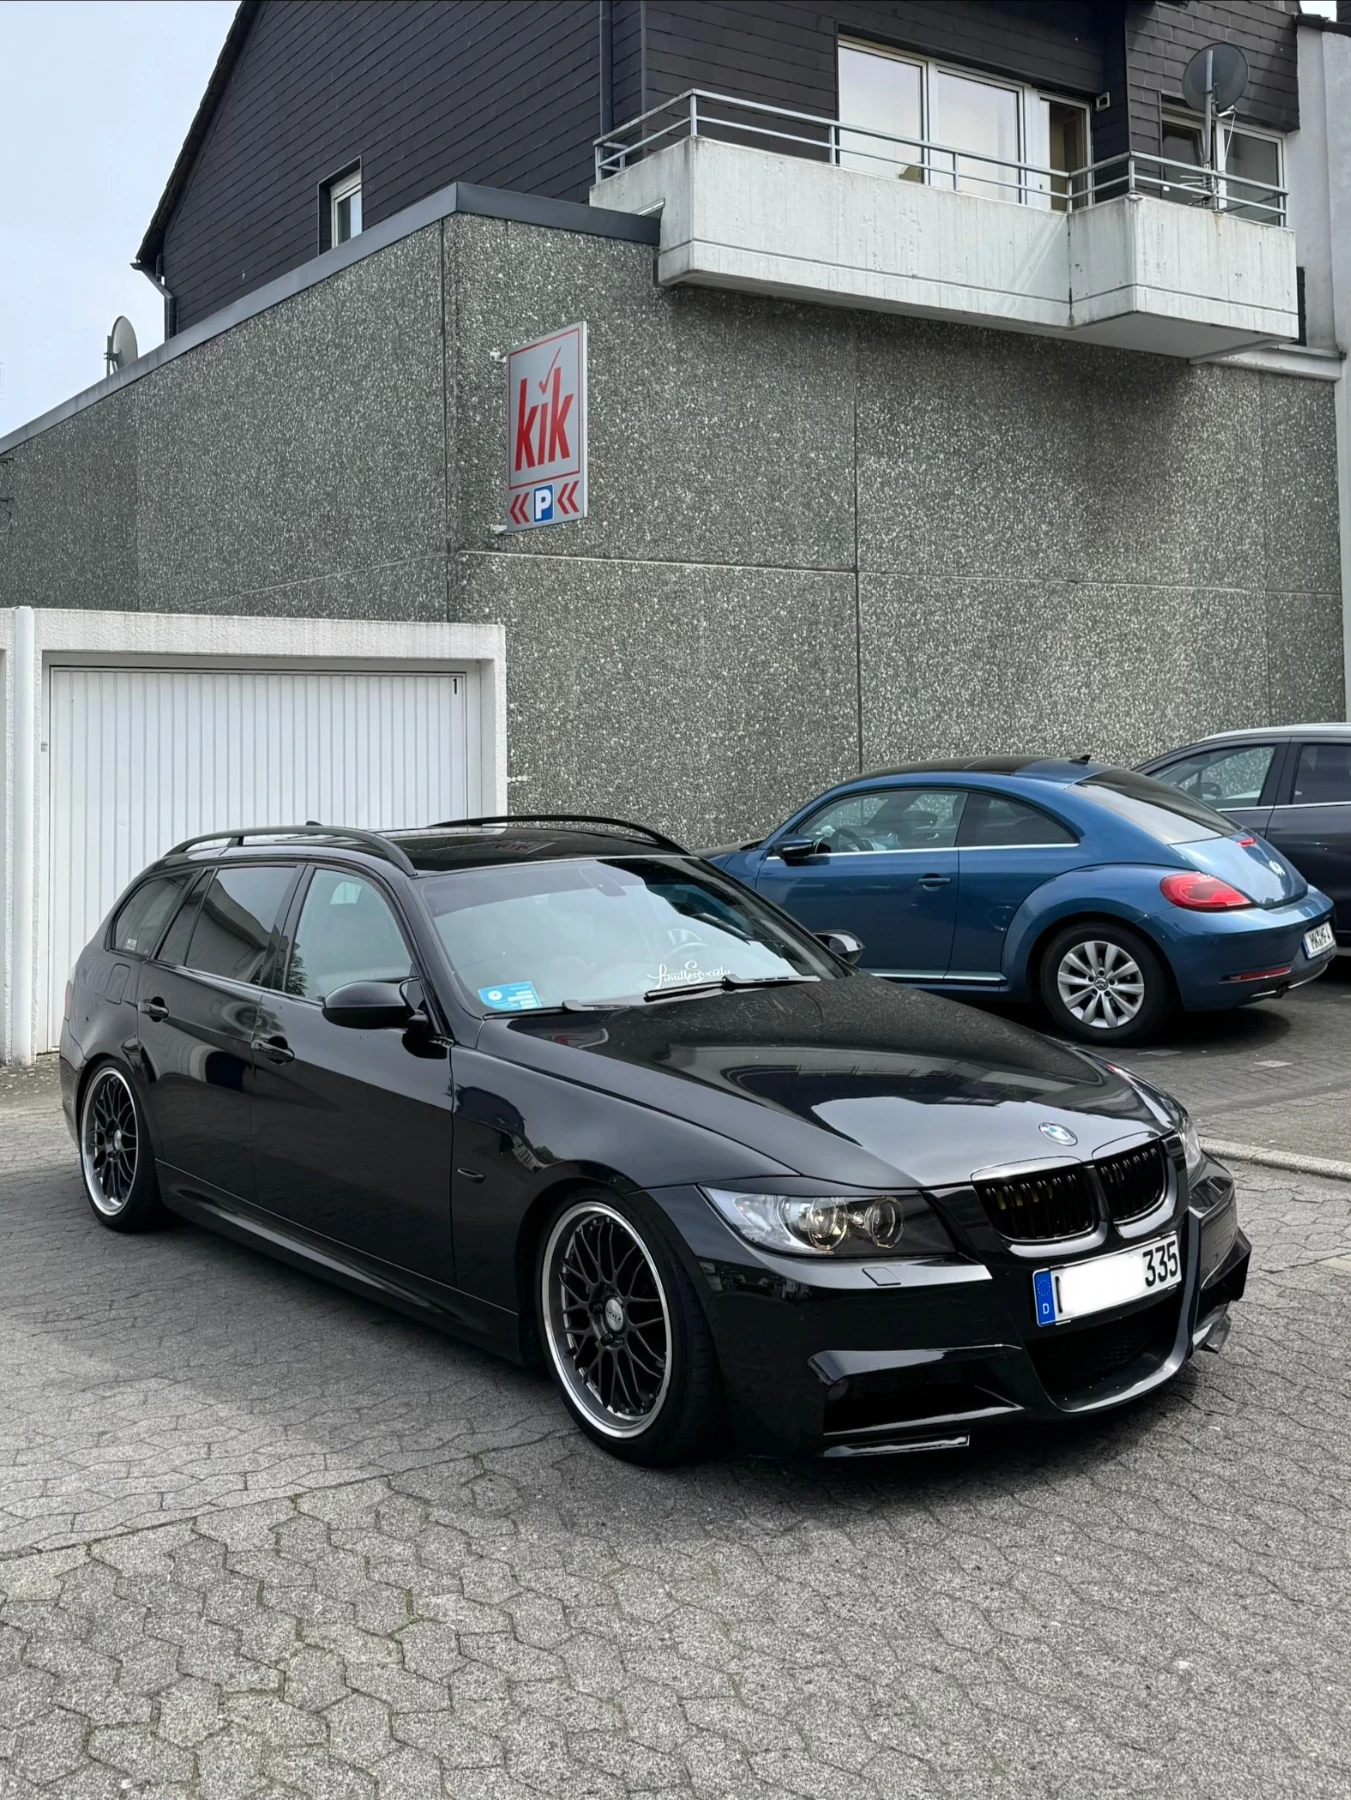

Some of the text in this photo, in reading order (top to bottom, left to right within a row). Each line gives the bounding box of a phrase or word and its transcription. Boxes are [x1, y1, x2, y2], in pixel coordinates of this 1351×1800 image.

[534, 488, 552, 520] P
[452, 678, 458, 695] 1
[1142, 1240, 1178, 1287] 335
[1042, 1303, 1050, 1314] D
